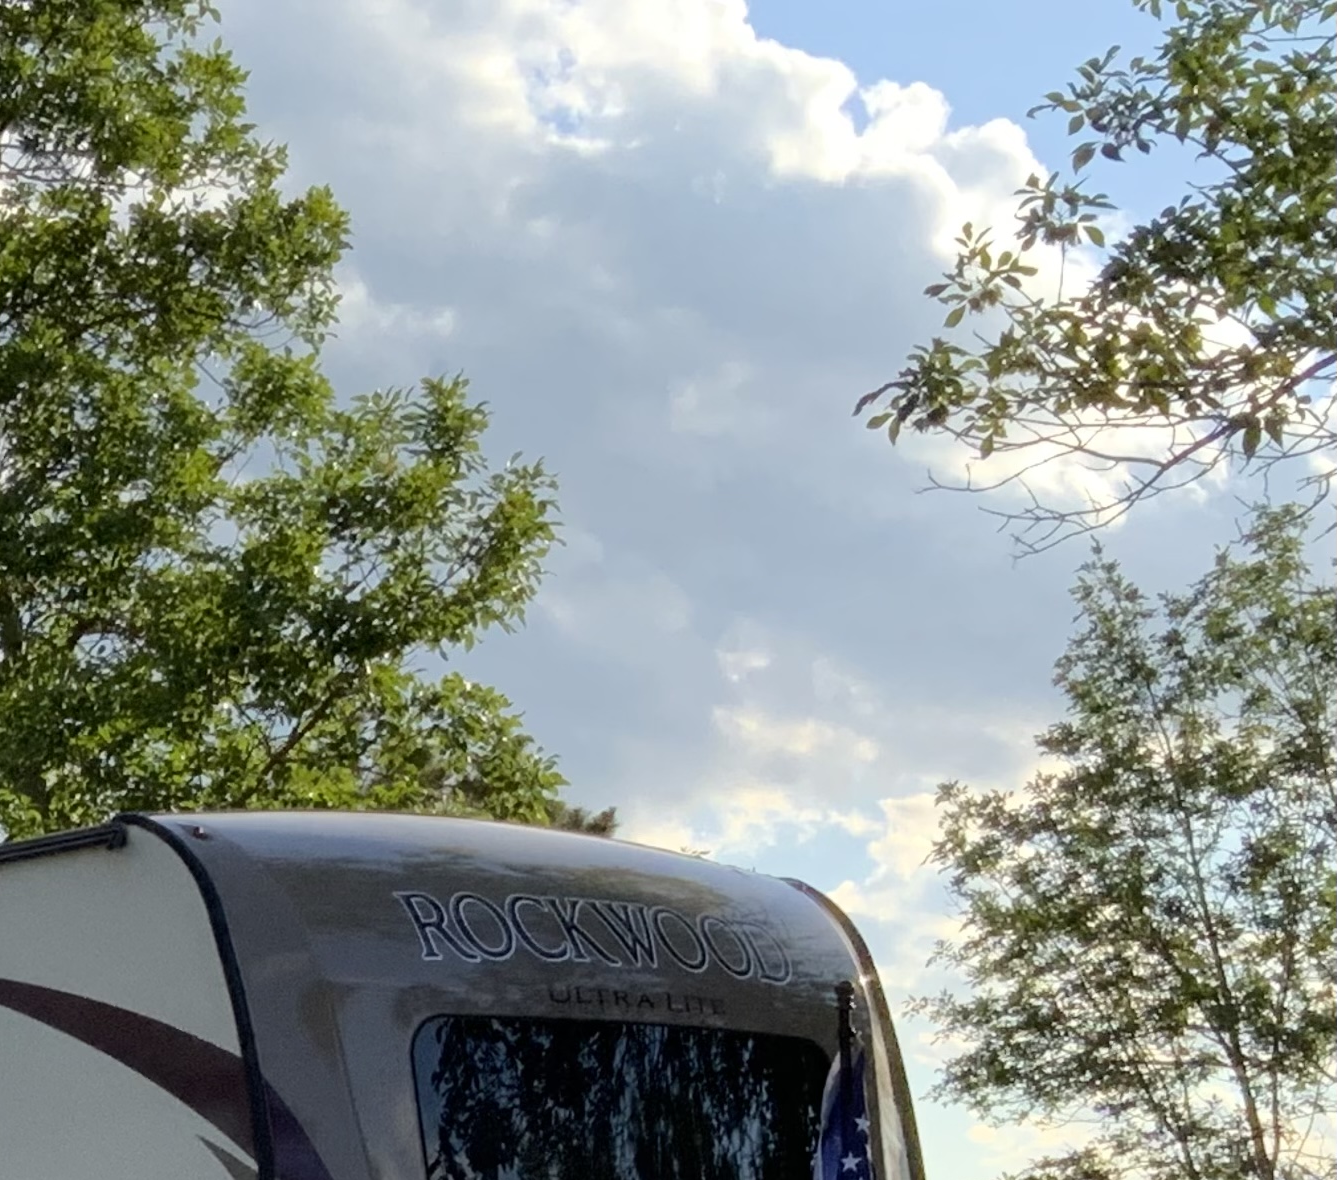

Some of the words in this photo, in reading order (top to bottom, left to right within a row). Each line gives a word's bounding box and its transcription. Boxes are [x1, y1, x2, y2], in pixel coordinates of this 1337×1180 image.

[393, 891, 792, 985] ROCKWOOD
[549, 986, 655, 1008] ULTRA
[666, 991, 727, 1015] LITE
